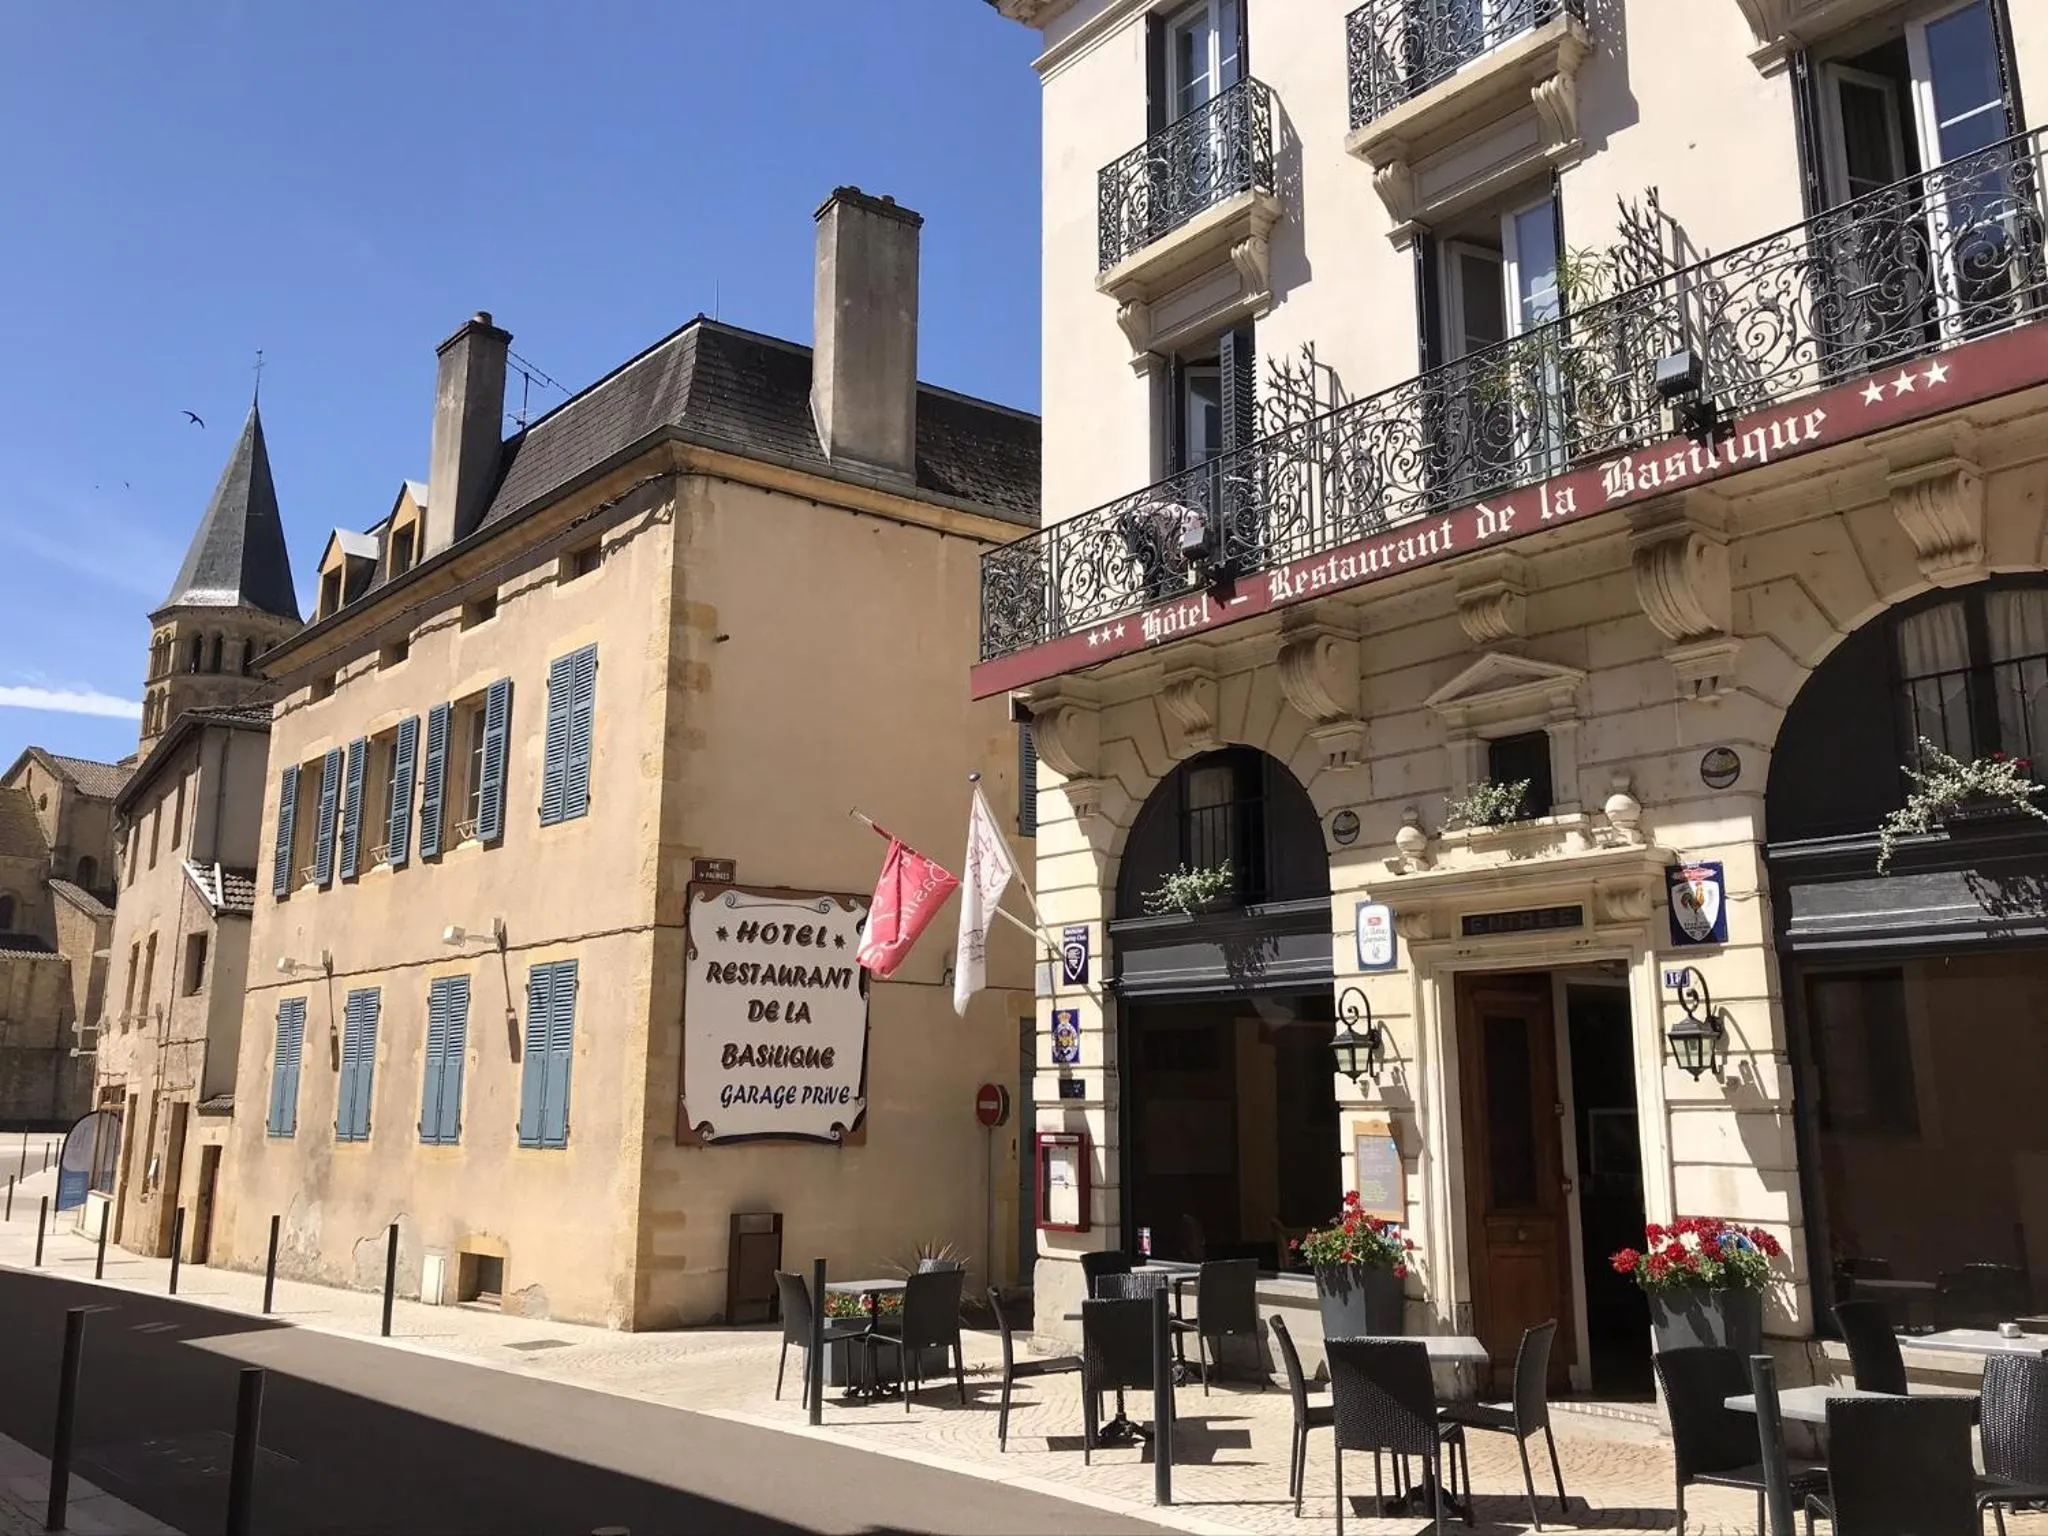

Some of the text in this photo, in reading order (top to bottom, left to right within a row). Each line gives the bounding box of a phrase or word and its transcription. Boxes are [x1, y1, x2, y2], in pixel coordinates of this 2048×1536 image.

[1141, 594, 1211, 644] Hôtel
[1268, 519, 1453, 602] Restaurant
[1475, 503, 1517, 541] de
[1539, 483, 1577, 521] la
[1598, 407, 1828, 501] Basilique
[735, 920, 828, 948] HOTEL
[705, 961, 854, 990] RESTAURANT
[747, 999, 812, 1024] DE LA
[721, 1043, 835, 1070] BASILIQUE
[720, 1084, 850, 1109] GARAGE PRIVE
